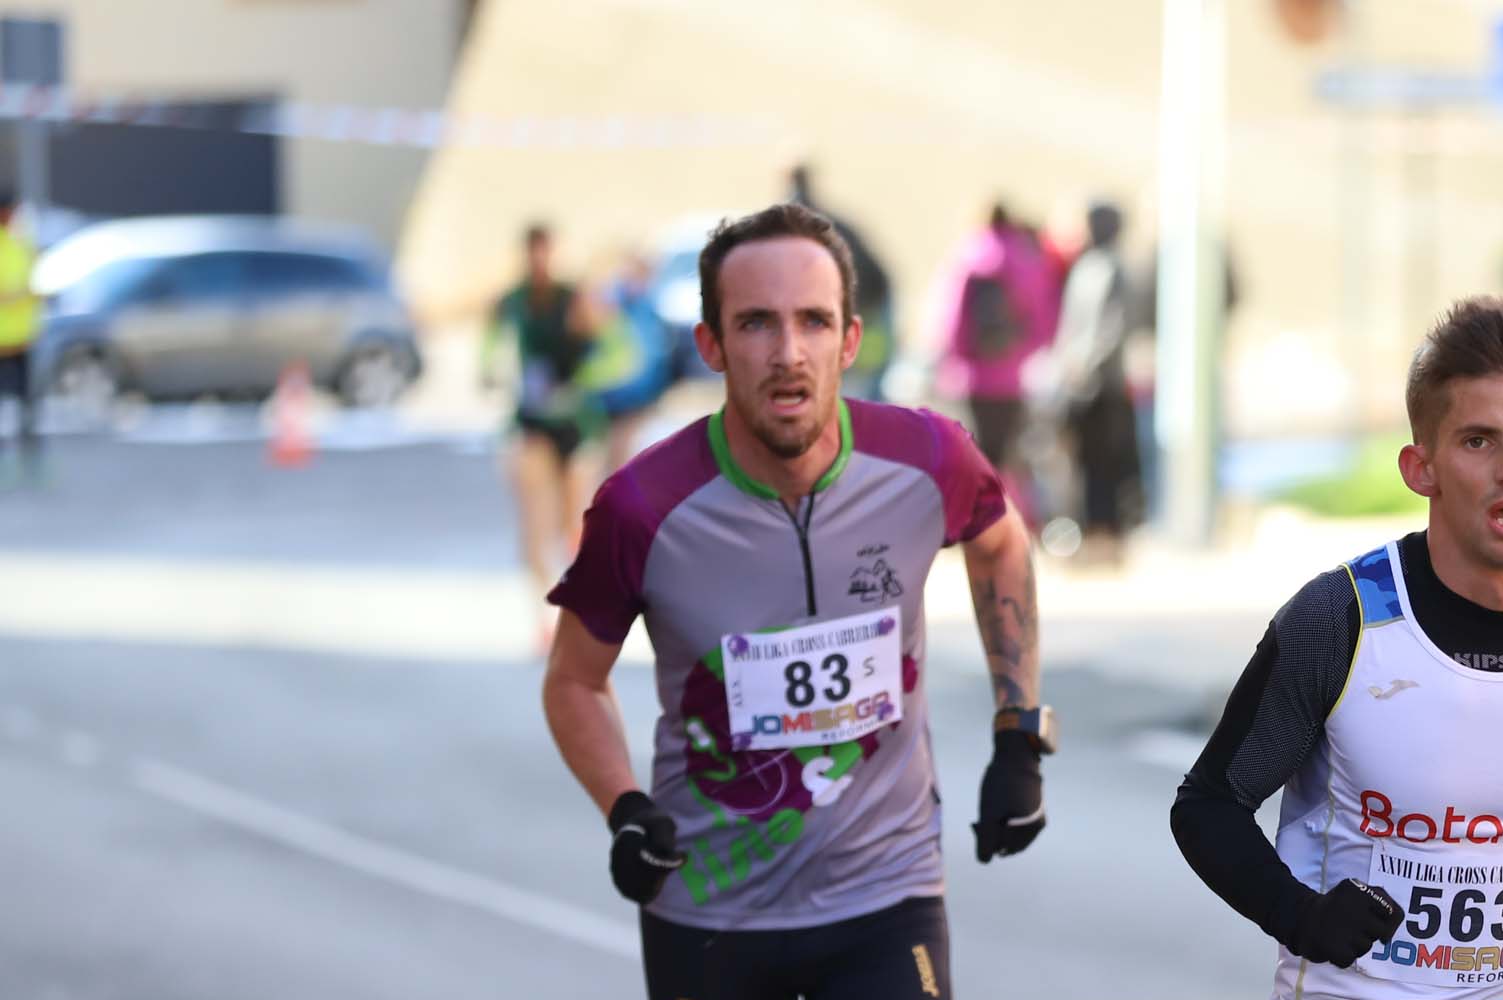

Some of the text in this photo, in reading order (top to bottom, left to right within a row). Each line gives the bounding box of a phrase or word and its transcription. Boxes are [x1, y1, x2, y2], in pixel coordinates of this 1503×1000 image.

[783, 653, 852, 709] 83
[1378, 854, 1414, 879] XXVII
[1415, 862, 1444, 883] LIGA
[1448, 865, 1487, 885] CROSS
